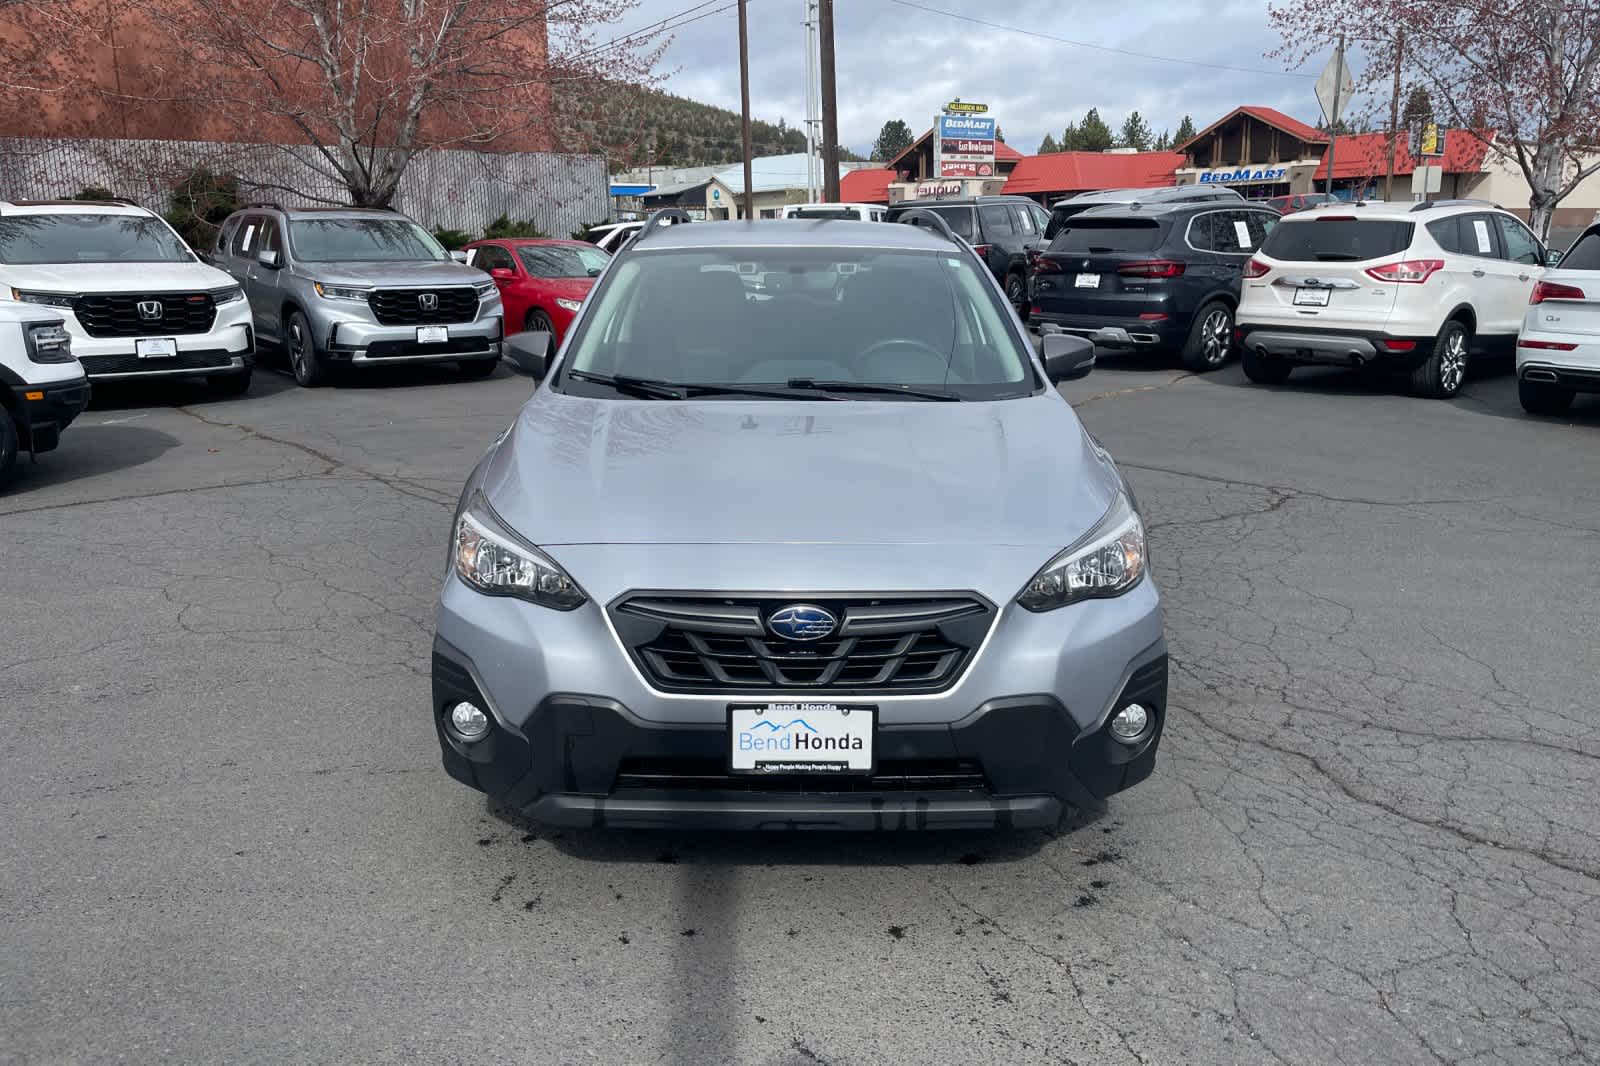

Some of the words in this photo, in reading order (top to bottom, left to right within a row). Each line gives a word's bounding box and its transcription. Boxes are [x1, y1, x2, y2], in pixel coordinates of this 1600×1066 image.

[1200, 168, 1285, 183] BEDMART
[768, 703, 797, 711] Bend
[801, 703, 836, 711] Honda
[740, 732, 790, 750] Bend
[795, 732, 863, 750] Honda
